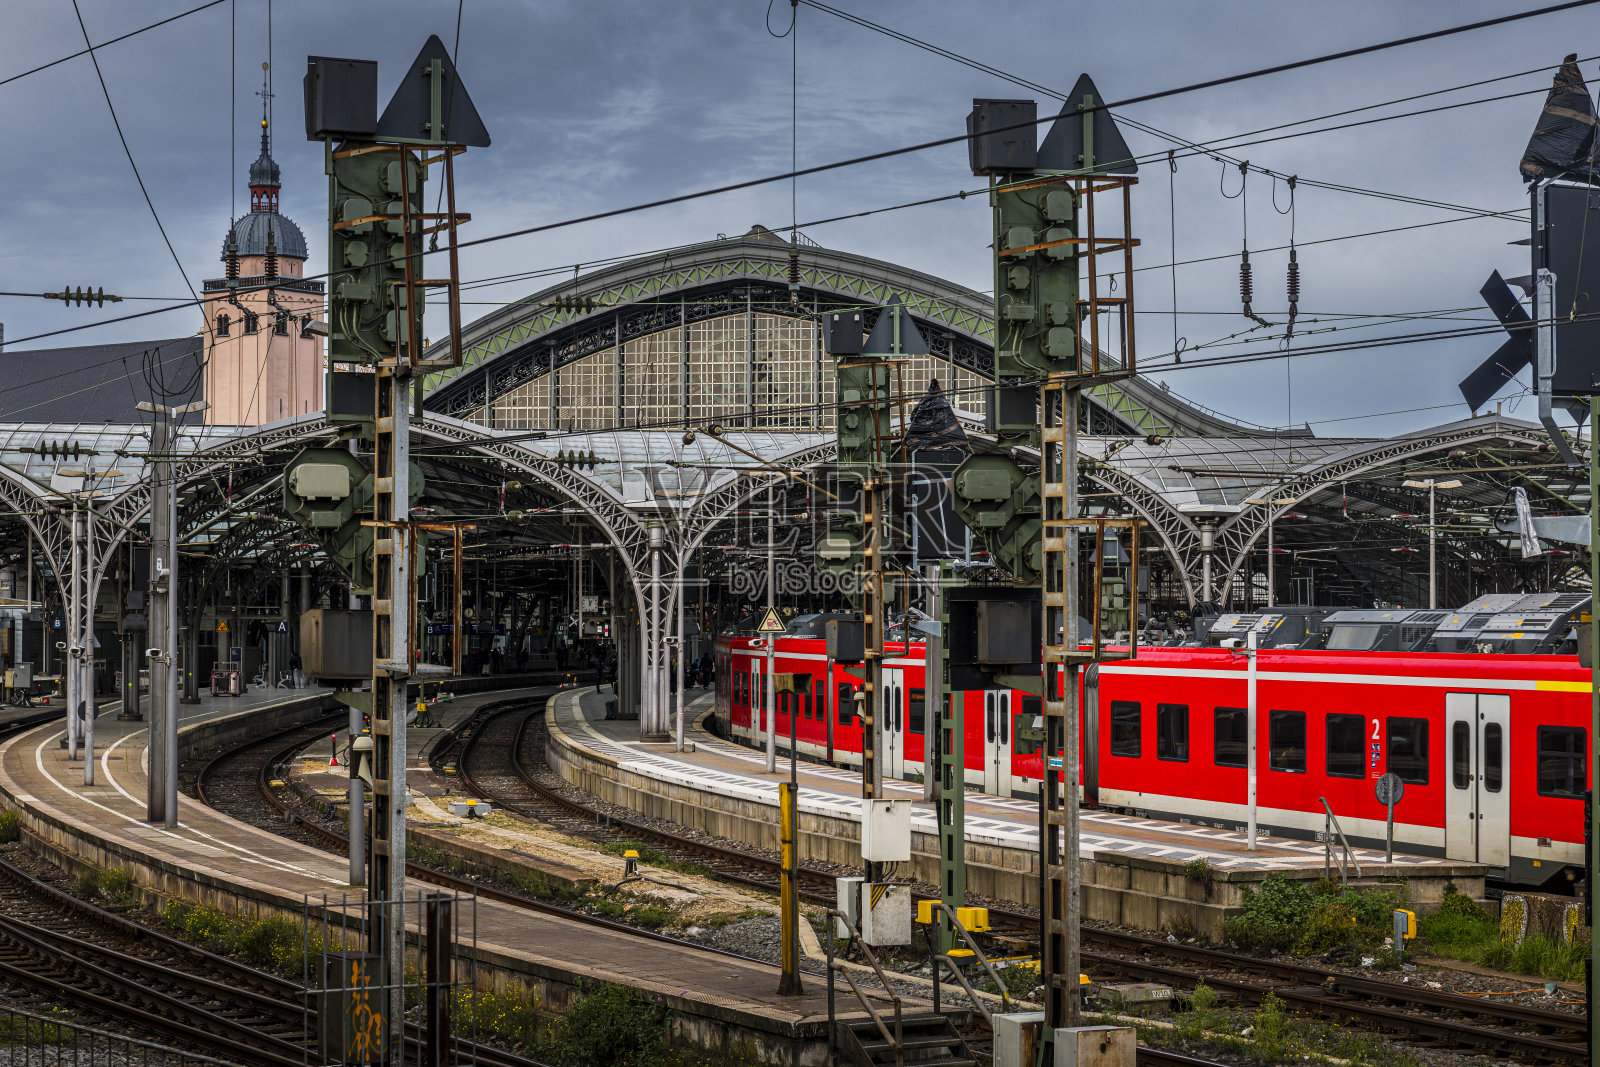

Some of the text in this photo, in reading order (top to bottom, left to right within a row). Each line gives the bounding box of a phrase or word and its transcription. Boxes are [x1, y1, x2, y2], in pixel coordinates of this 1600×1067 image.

[278, 621, 287, 632] A
[427, 626, 433, 634] B
[1371, 718, 1380, 740] 2
